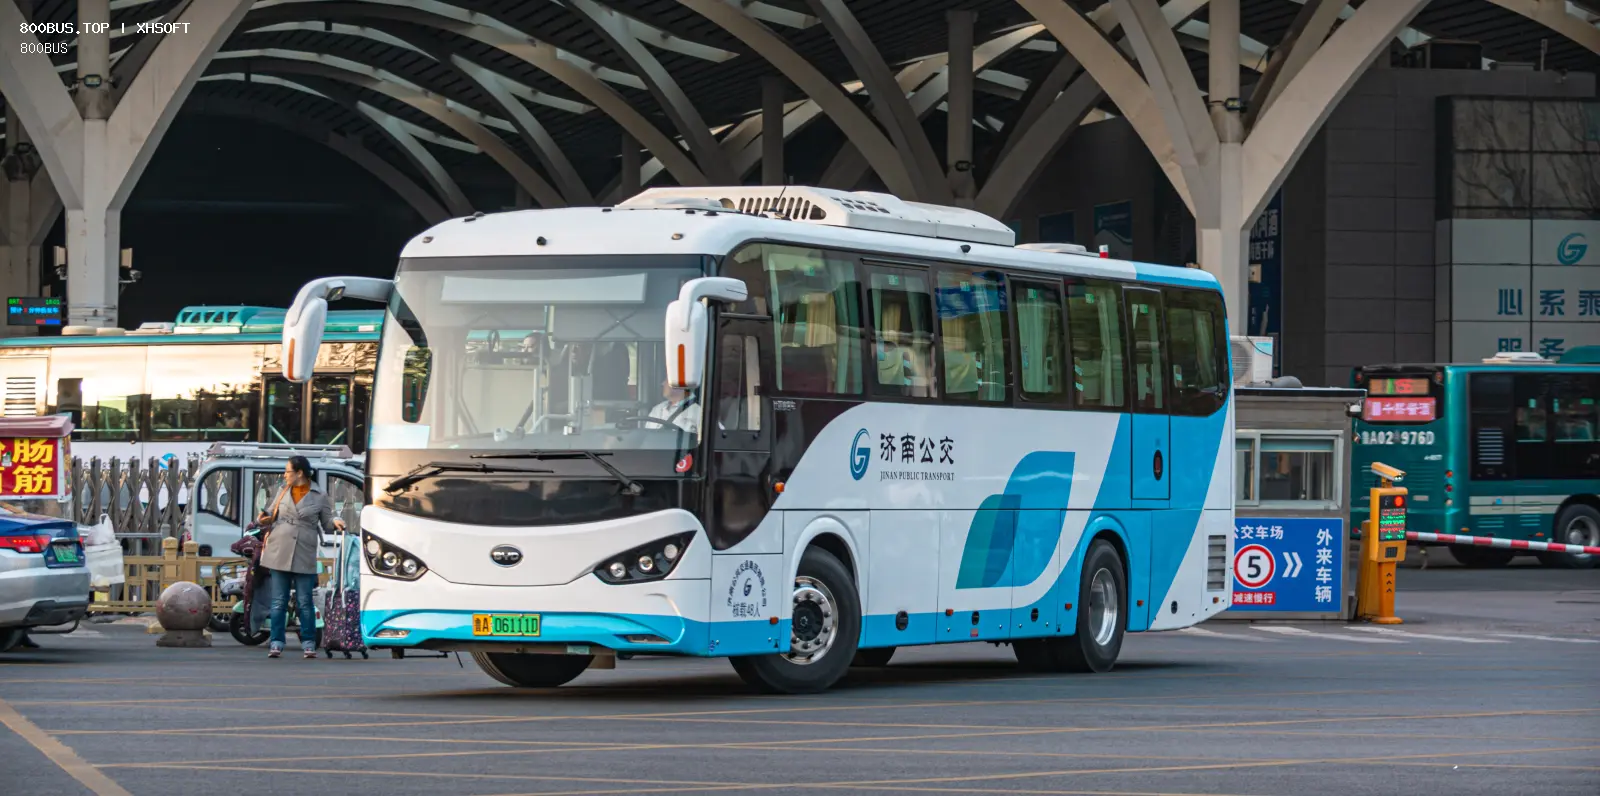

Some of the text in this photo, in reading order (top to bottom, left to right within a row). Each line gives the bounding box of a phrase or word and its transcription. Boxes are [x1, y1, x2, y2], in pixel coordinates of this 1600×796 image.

[1497, 288, 1600, 316] 心系乘
[880, 432, 954, 465] 济南公交
[880, 470, 955, 481] JINAN PUBLIC TRANSPORT
[493, 551, 520, 561] BYD
[1247, 555, 1261, 579] 5
[1315, 528, 1333, 603] 外来车辆
[1233, 592, 1273, 604] 减速慢行
